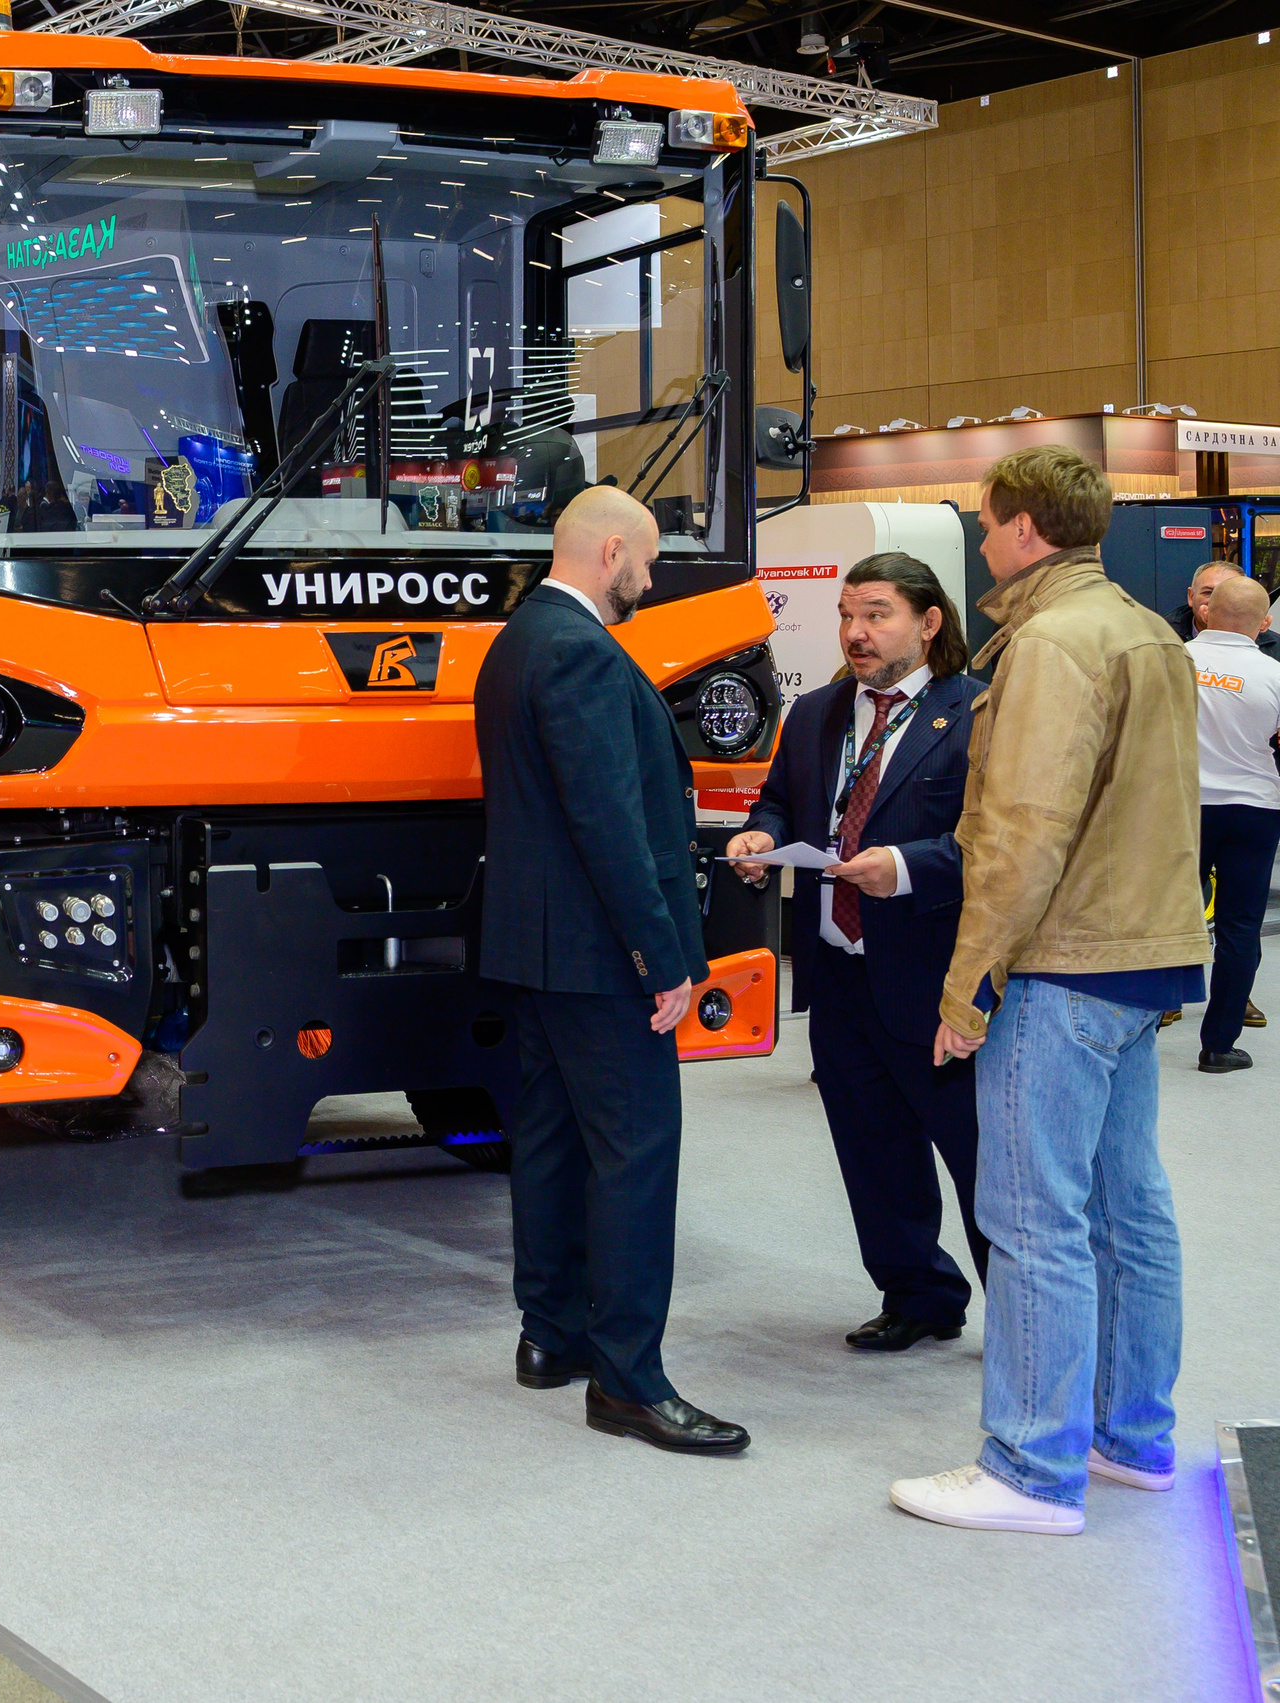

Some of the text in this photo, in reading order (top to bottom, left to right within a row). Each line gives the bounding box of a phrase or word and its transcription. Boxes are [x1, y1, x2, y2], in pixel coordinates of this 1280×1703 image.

[1186, 430, 1280, 446] САРДЭЧНА ЗА
[812, 567, 832, 576] MT
[262, 572, 490, 606] УНИРОСС
